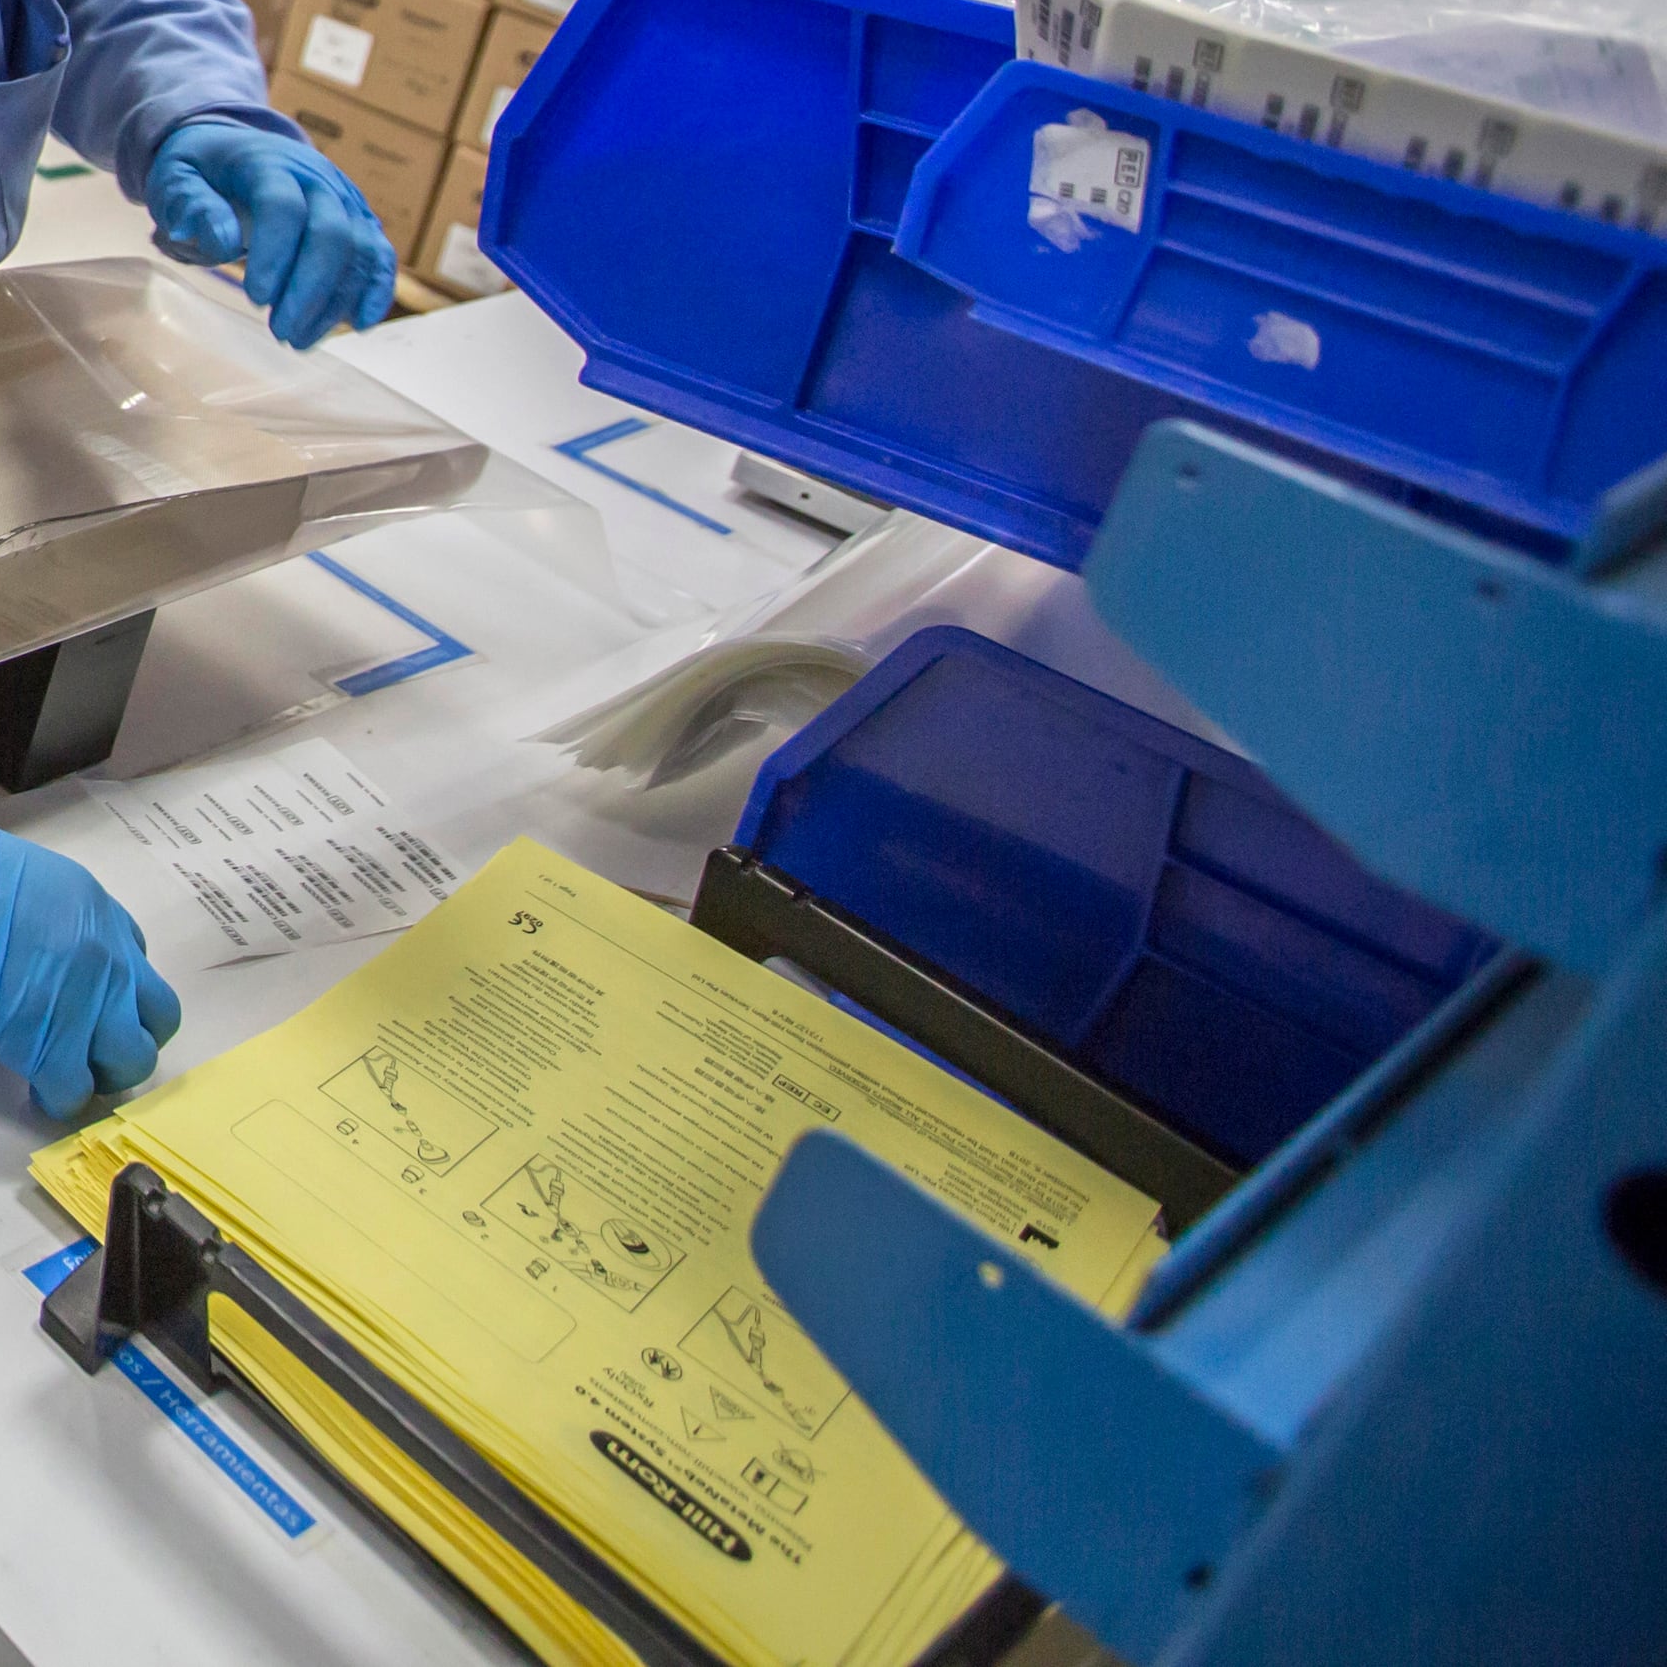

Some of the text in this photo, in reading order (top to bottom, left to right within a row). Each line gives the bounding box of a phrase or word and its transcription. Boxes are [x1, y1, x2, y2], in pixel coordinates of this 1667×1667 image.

[1121, 150, 1141, 187] REF
[516, 909, 544, 927] 0297
[776, 1078, 804, 1097] REP
[810, 1099, 832, 1114] EC
[157, 1388, 303, 1531] Herramientas
[572, 1383, 804, 1566] The System 4.0
[597, 1438, 743, 1553] Hill-Rom
